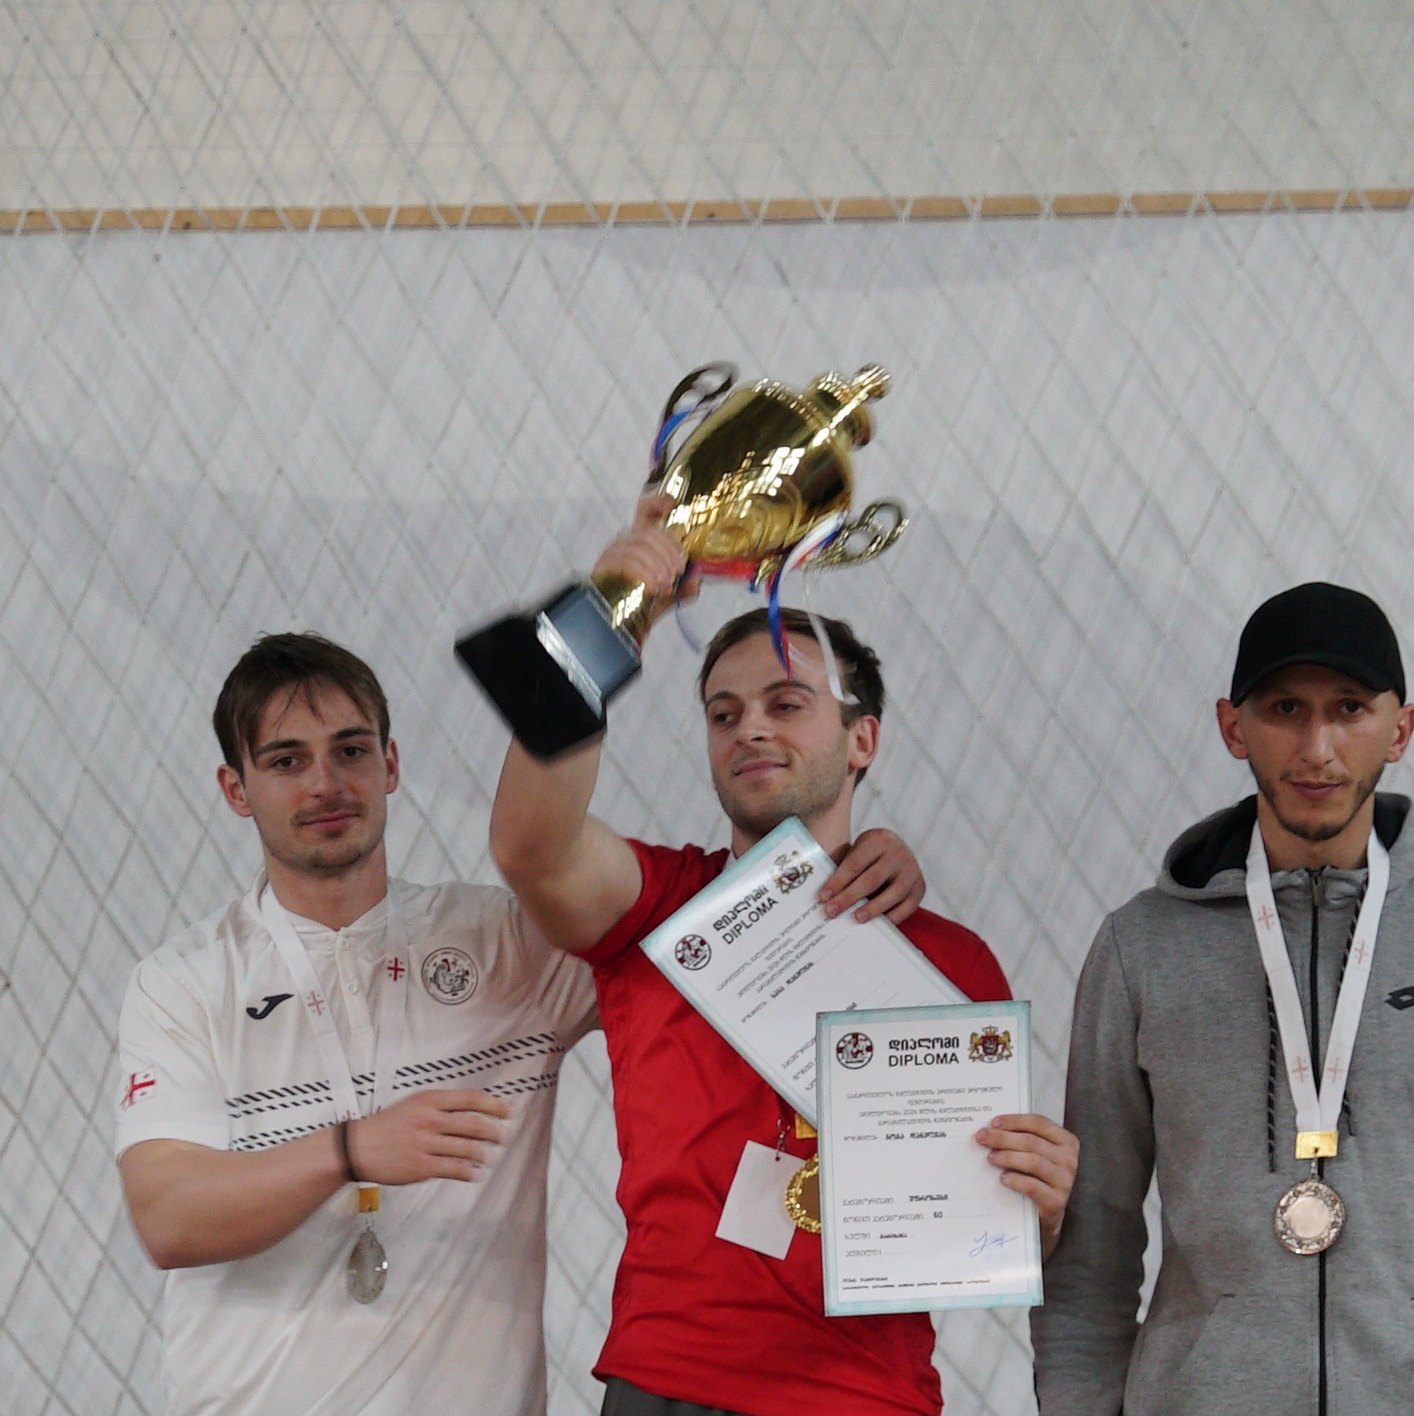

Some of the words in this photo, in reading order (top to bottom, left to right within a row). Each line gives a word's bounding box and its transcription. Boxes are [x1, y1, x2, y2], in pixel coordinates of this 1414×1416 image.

[721, 896, 779, 945] DIPLOMA
[888, 1036, 960, 1052] დიპლომი
[888, 1052, 960, 1067] DIPLOMA
